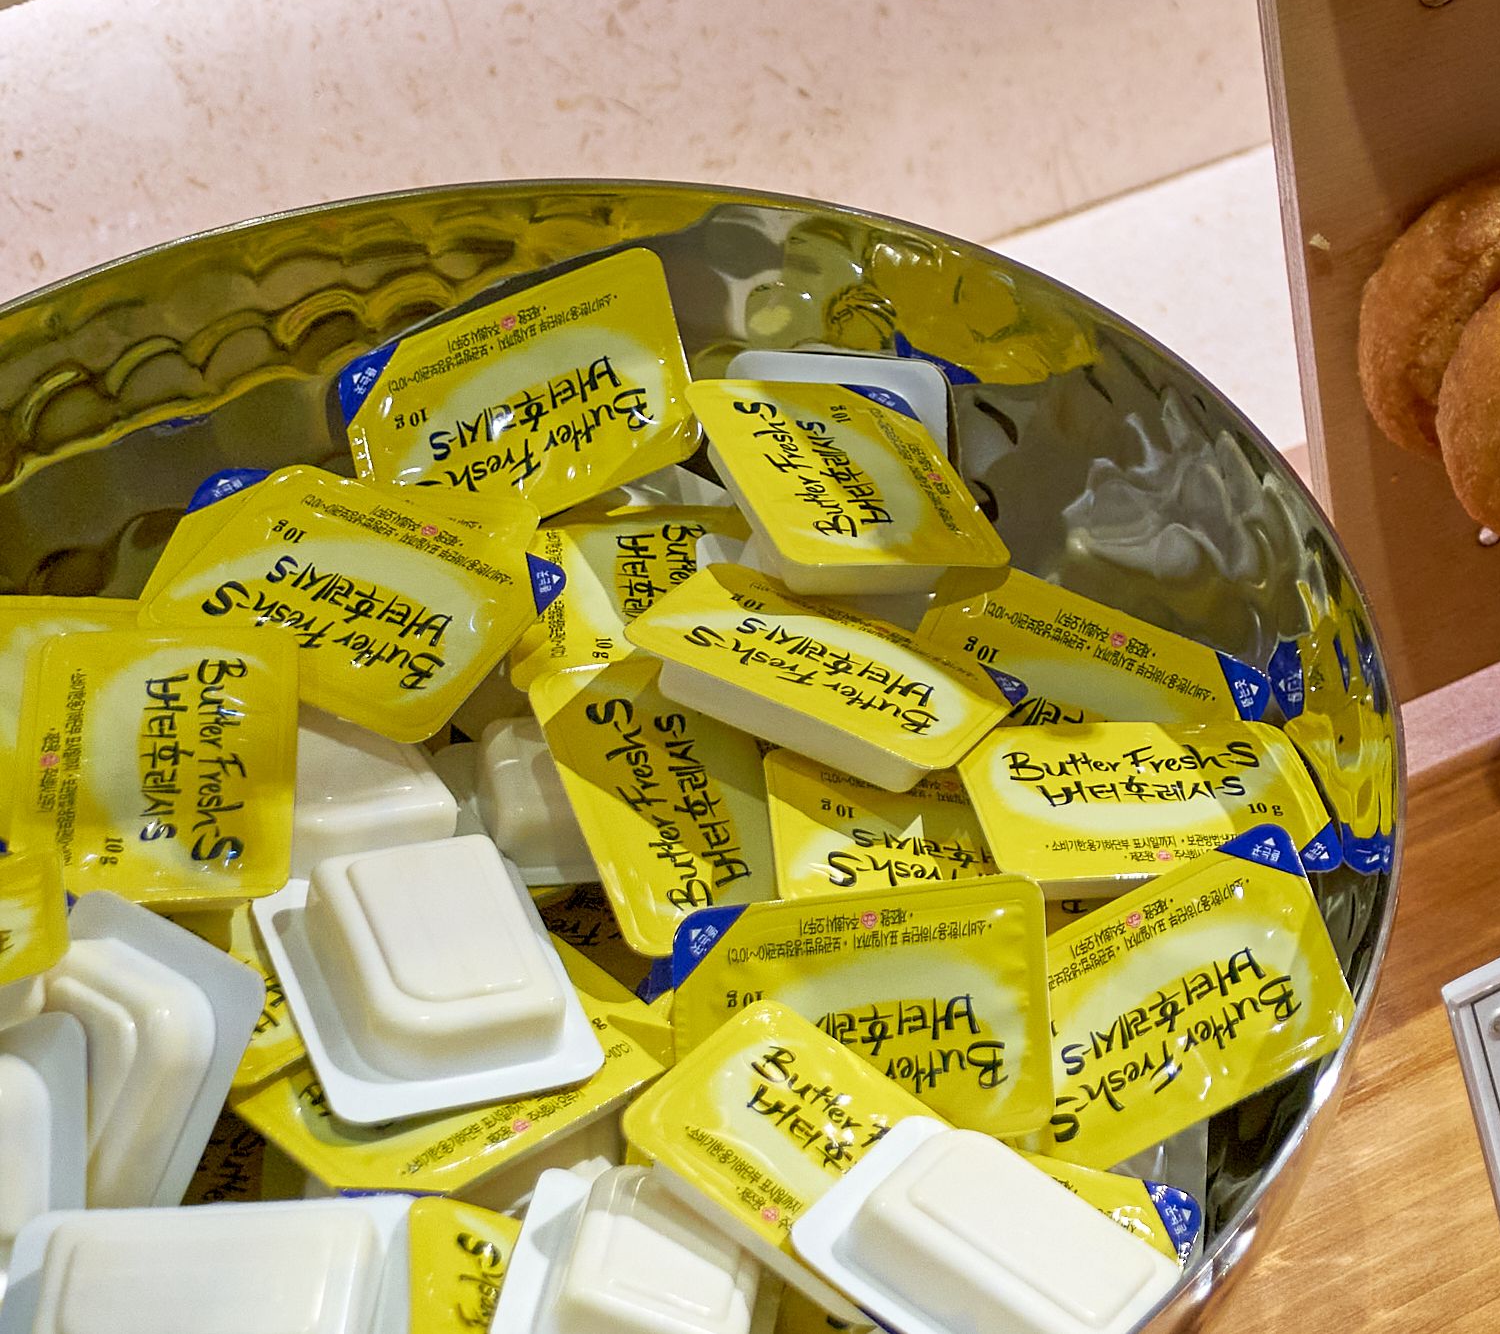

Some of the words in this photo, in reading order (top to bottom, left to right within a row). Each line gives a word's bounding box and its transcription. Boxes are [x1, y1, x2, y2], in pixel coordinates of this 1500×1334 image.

[394, 414, 405, 430] g
[410, 408, 427, 427] 10
[544, 388, 654, 452] Butter
[835, 413, 852, 423] 10
[733, 402, 811, 473] Fresh-S
[416, 443, 541, 492] Fresh
[798, 475, 857, 537] Butter
[272, 520, 288, 532] g
[283, 528, 306, 543] 10
[201, 581, 335, 648] Fresh-S
[266, 555, 452, 647] 버터후레시-S
[744, 599, 765, 610] 10
[1054, 609, 1082, 636] 오뚜기
[1078, 619, 1109, 643] 주식회사
[334, 619, 445, 690] Butter
[595, 638, 613, 649] 10
[684, 626, 818, 686] Fresh-S
[963, 636, 978, 652] g
[977, 646, 999, 663] 10
[1125, 638, 1152, 658] 제조원
[736, 618, 934, 707] 버터후레시-S
[1093, 645, 1137, 672] 표시일까지
[1135, 662, 1212, 701] 소비기한:용기하단부
[197, 659, 247, 747] Butter
[824, 683, 939, 735] Butter
[139, 674, 194, 841] 버터후레시S
[585, 699, 667, 812] Fresh-S
[1002, 752, 1120, 781] Butter
[1123, 742, 1259, 777] Fresh-S
[654, 714, 752, 887] 버터후레시-S
[1036, 775, 1245, 807] 버터후레시-S
[187, 753, 247, 862] Fresh-S
[821, 799, 831, 811] g
[836, 805, 853, 819] 10
[1248, 803, 1267, 814] 10
[1272, 805, 1283, 816] g
[105, 838, 124, 853] 10
[852, 829, 993, 869] 후레시-S
[1133, 836, 1177, 849] 표시일까지
[1251, 842, 1281, 863] 뜯는곳
[99, 856, 118, 866] g
[650, 816, 713, 911] Butter
[828, 851, 956, 887] resh-S
[880, 908, 907, 926] 제조원
[1142, 899, 1168, 920] 제조원
[799, 918, 825, 936] 오뚜기
[826, 914, 859, 933] 주식회사
[902, 920, 986, 944] 소비기한:용기하단부
[1094, 921, 1126, 947] 주식회사
[1123, 918, 1167, 951] 표시일까지
[690, 925, 718, 955] 뜯는곳
[853, 930, 899, 950] 표시일까지
[1070, 936, 1095, 959] 오뚜기
[726, 990, 737, 1008] g
[1061, 947, 1266, 1076] 버터후레시-S
[1183, 976, 1301, 1053] Butter
[751, 1046, 861, 1130] Butter
[1049, 1041, 1182, 1143] Fresh-S
[686, 1129, 762, 1184] 소비기한:용기하단부
